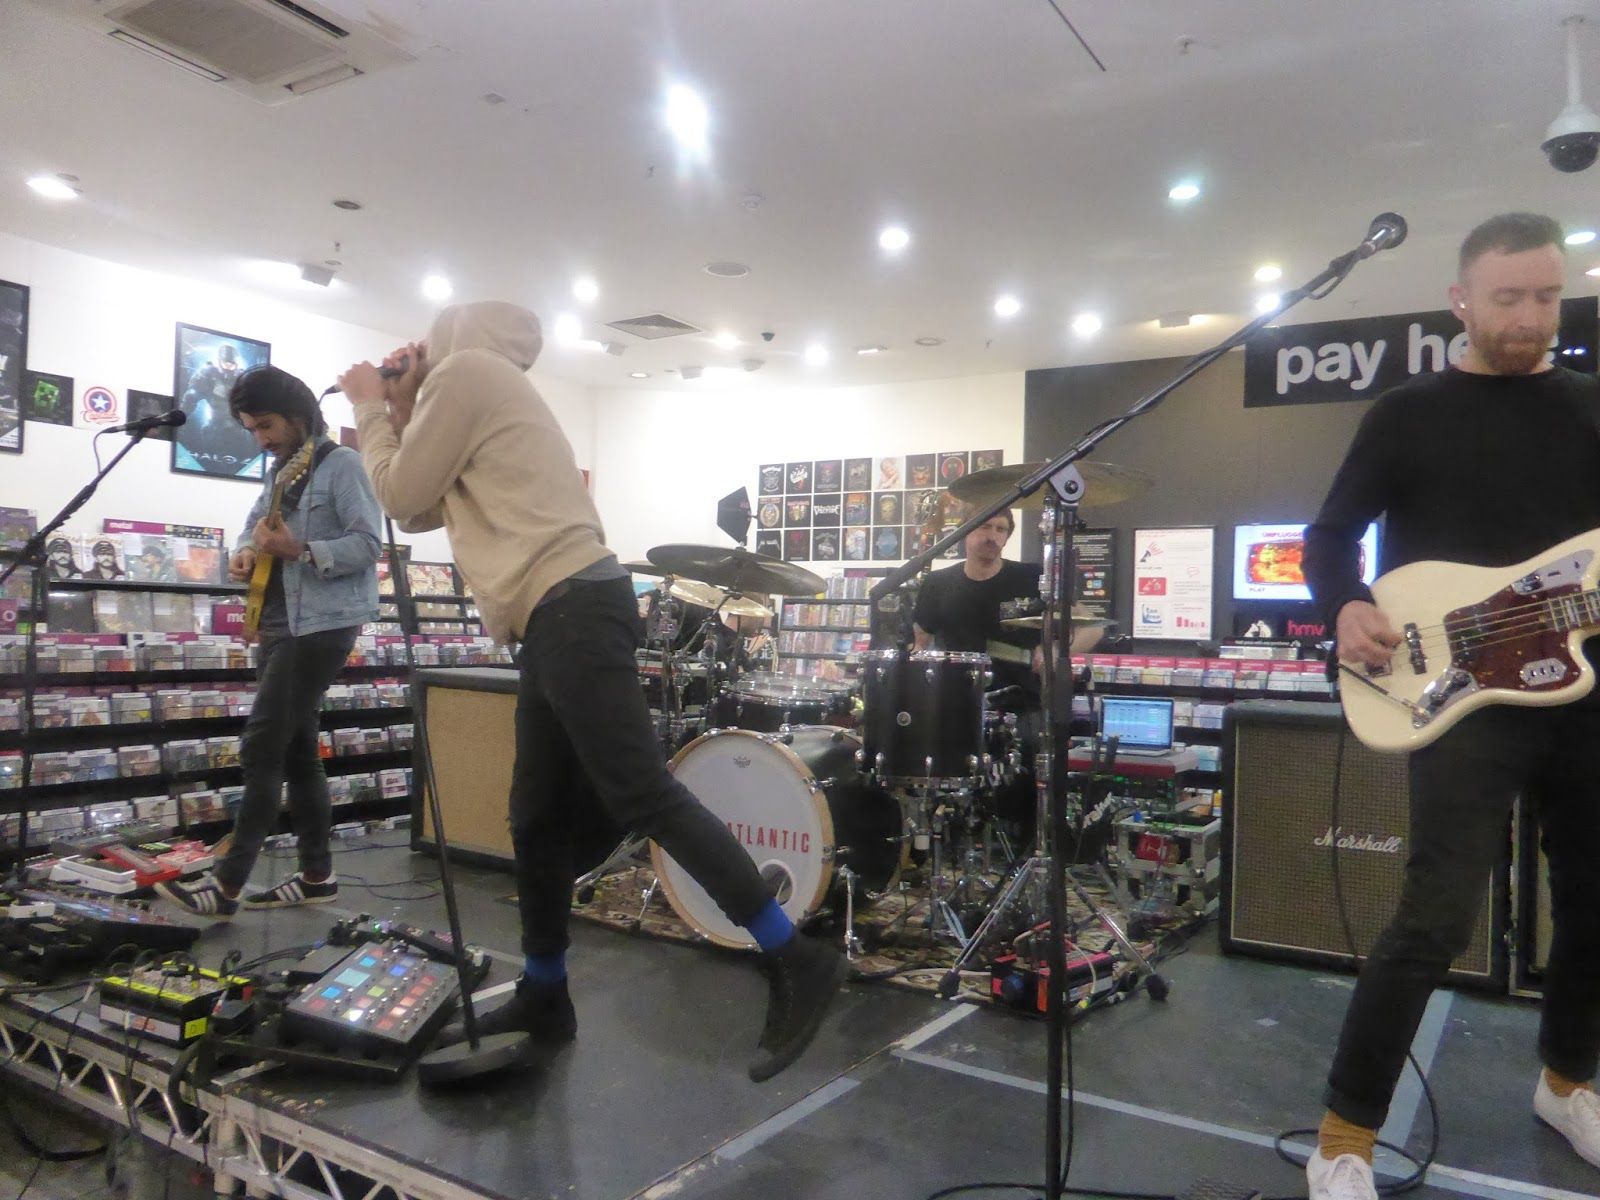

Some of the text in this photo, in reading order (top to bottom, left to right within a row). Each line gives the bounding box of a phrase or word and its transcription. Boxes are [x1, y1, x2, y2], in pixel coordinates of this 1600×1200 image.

[1276, 339, 1386, 395] pay
[1287, 619, 1325, 636] hmv
[1314, 826, 1402, 853] Marshall
